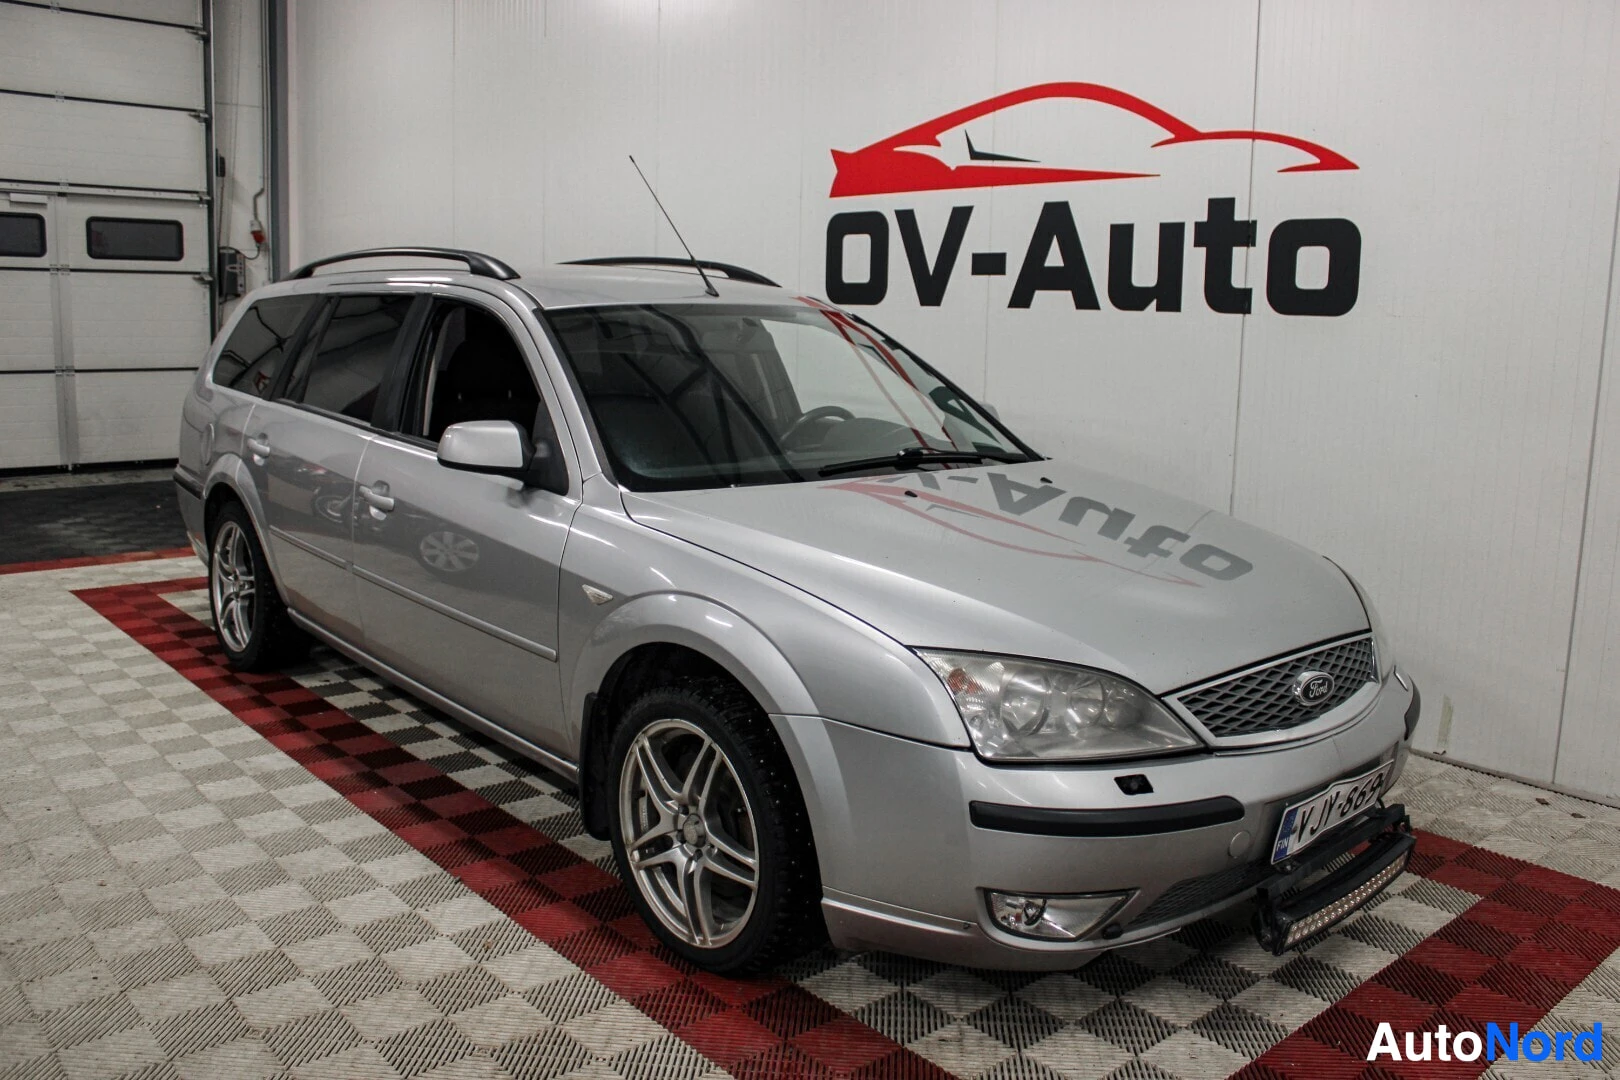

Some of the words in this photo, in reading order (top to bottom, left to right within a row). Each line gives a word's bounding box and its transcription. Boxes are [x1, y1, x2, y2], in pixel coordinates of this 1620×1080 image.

[825, 197, 1362, 317] OV-Auto
[1308, 679, 1328, 698] Ford
[1297, 772, 1384, 843] VJY-869
[1276, 837, 1290, 852] FIN
